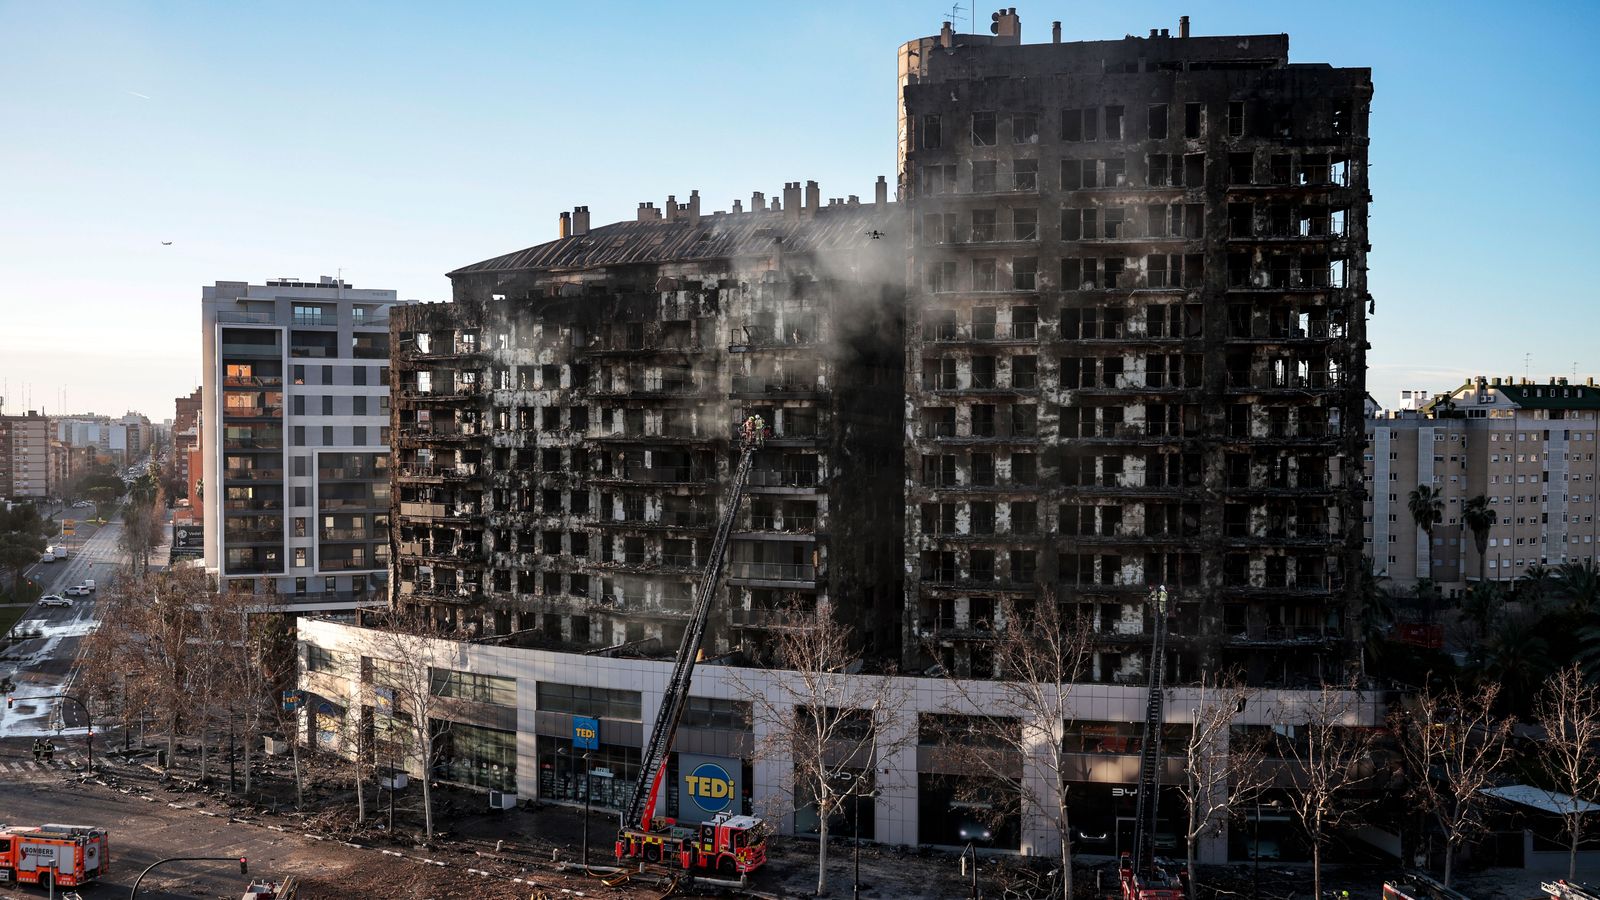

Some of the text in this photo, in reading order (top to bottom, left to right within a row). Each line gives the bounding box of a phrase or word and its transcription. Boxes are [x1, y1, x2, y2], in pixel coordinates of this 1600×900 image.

[575, 728, 595, 739] TEDi
[685, 775, 735, 801] TEDi
[1112, 787, 1143, 797] BY
[25, 847, 54, 855] BOMBERS
